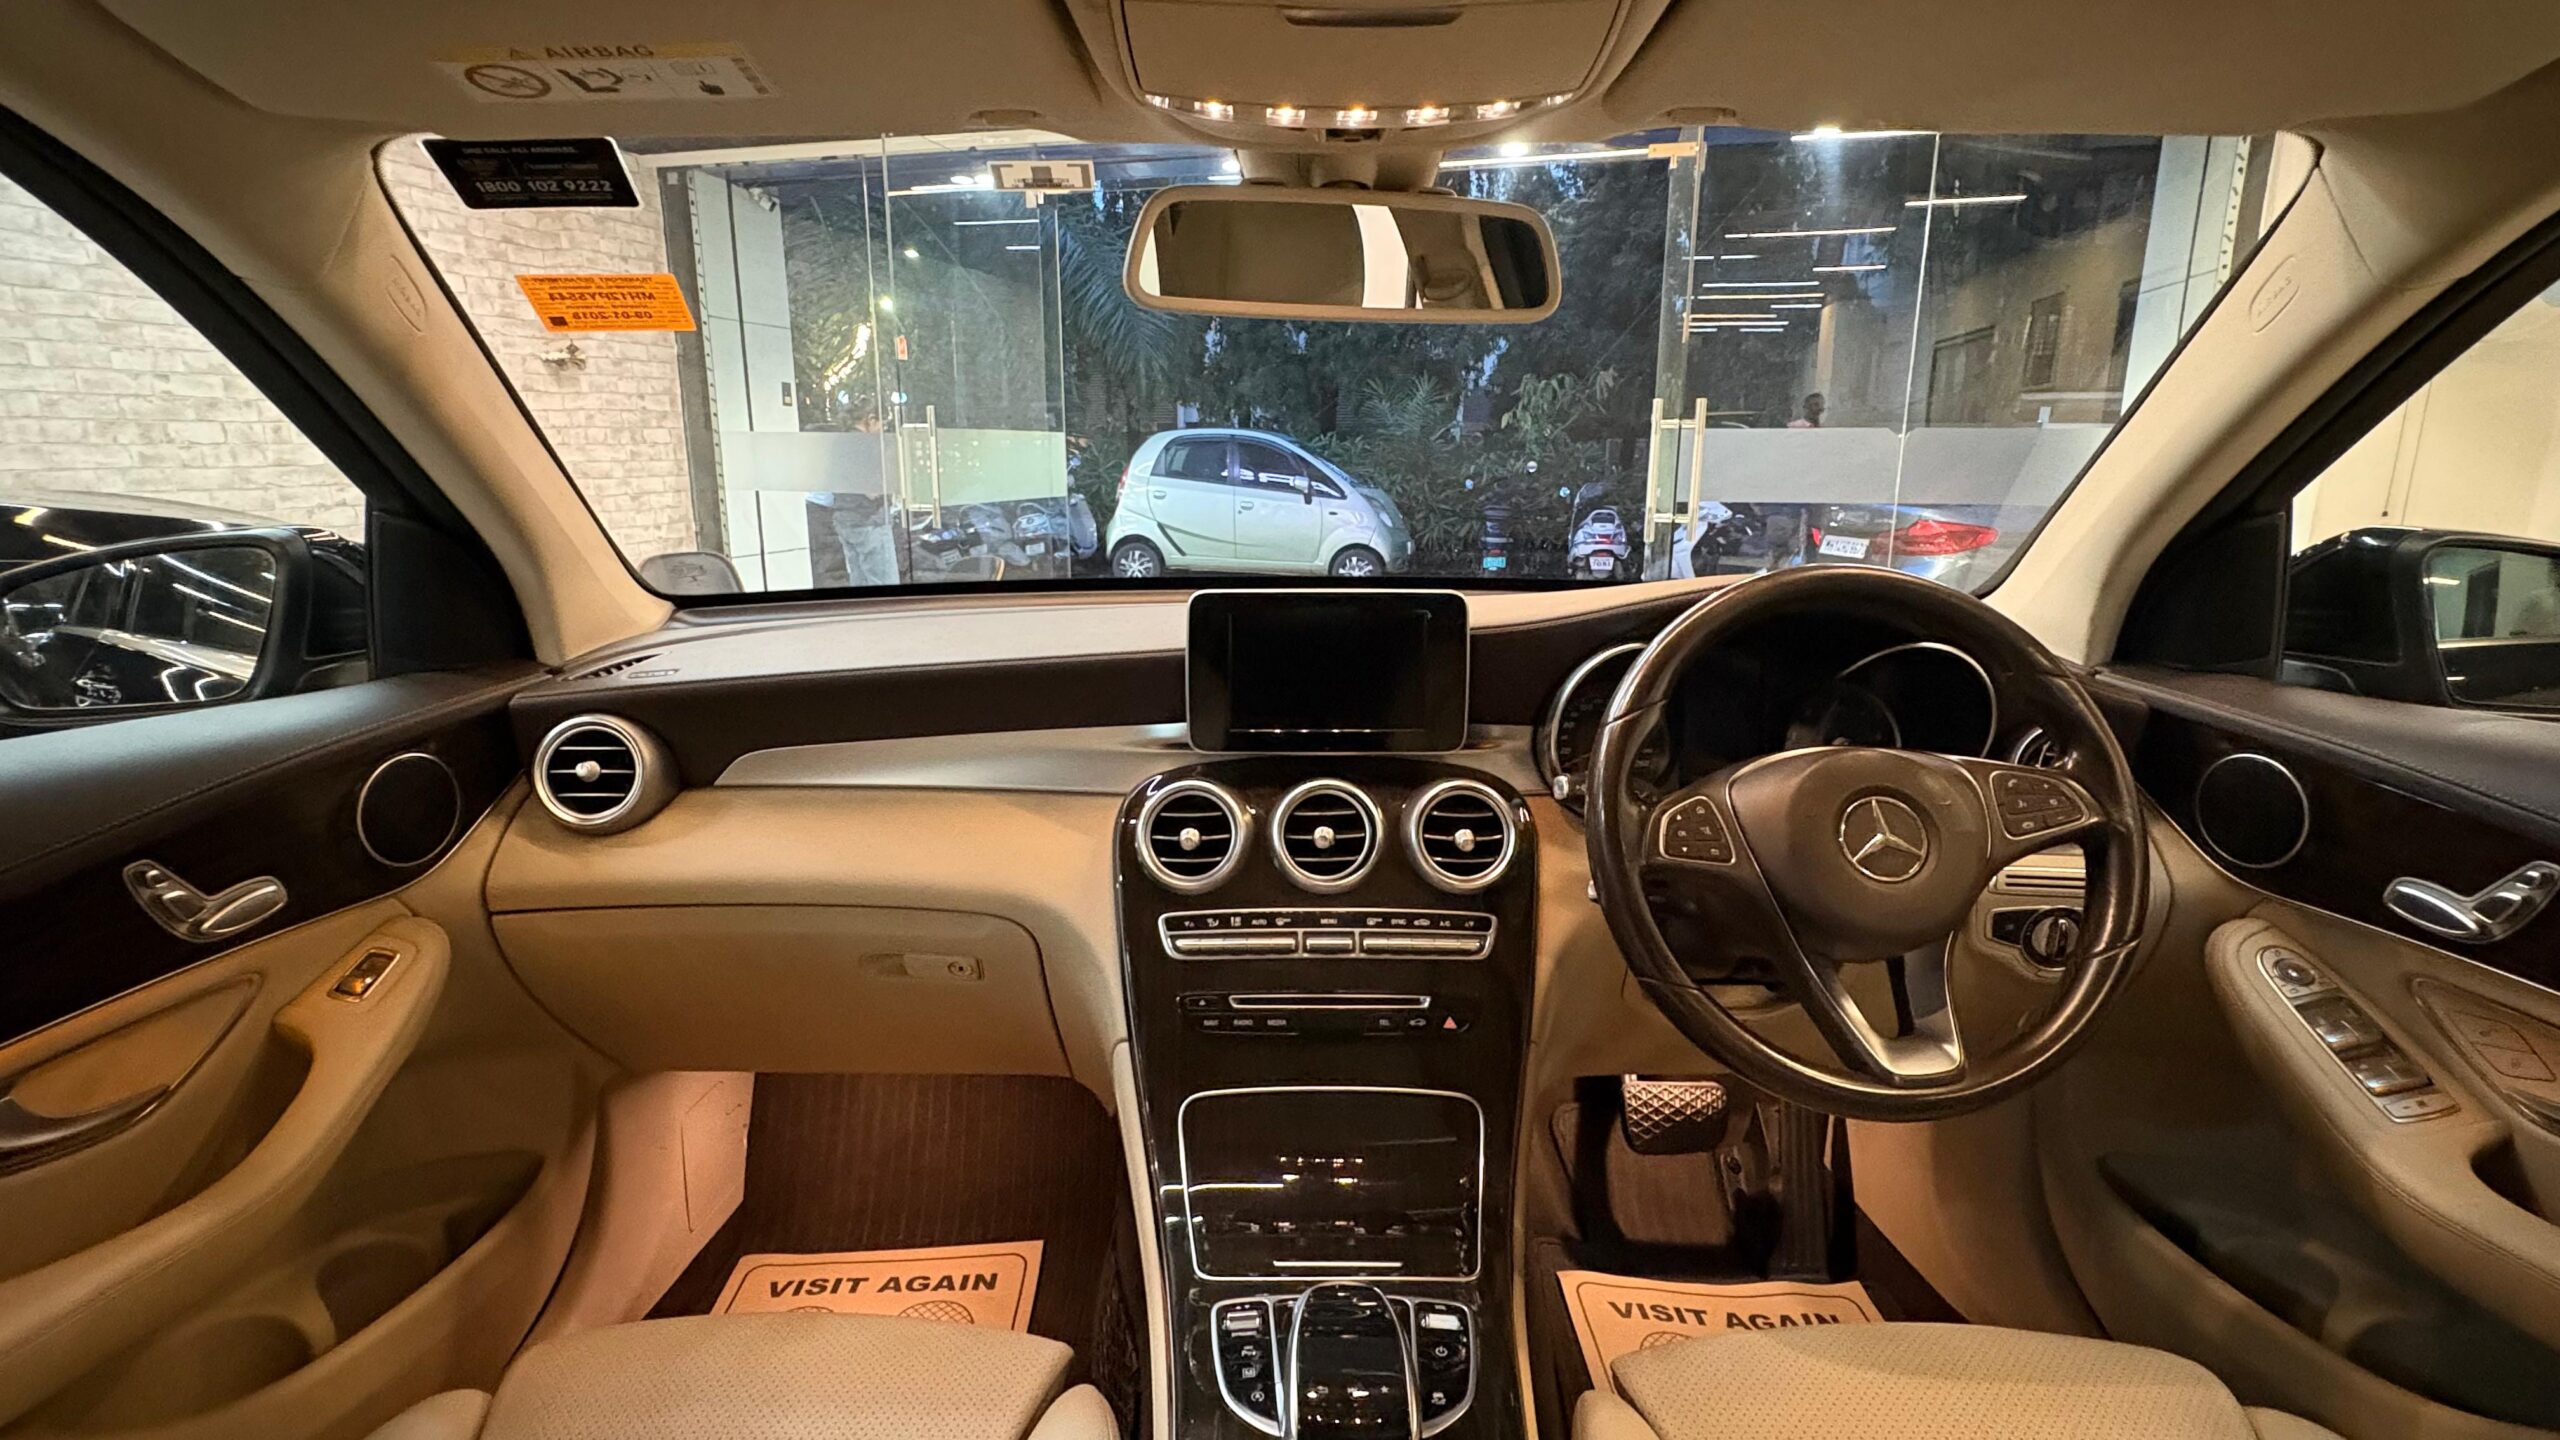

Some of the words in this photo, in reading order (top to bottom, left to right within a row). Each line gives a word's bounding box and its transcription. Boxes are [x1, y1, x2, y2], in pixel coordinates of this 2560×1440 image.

[544, 44, 655, 59] AIRBAG
[475, 180, 521, 193] 1800
[528, 180, 560, 192] 102
[563, 180, 613, 192] 9222
[769, 1277, 869, 1298] VISIT
[877, 1273, 998, 1293] AGAIN
[1608, 1301, 1708, 1327] VISIT
